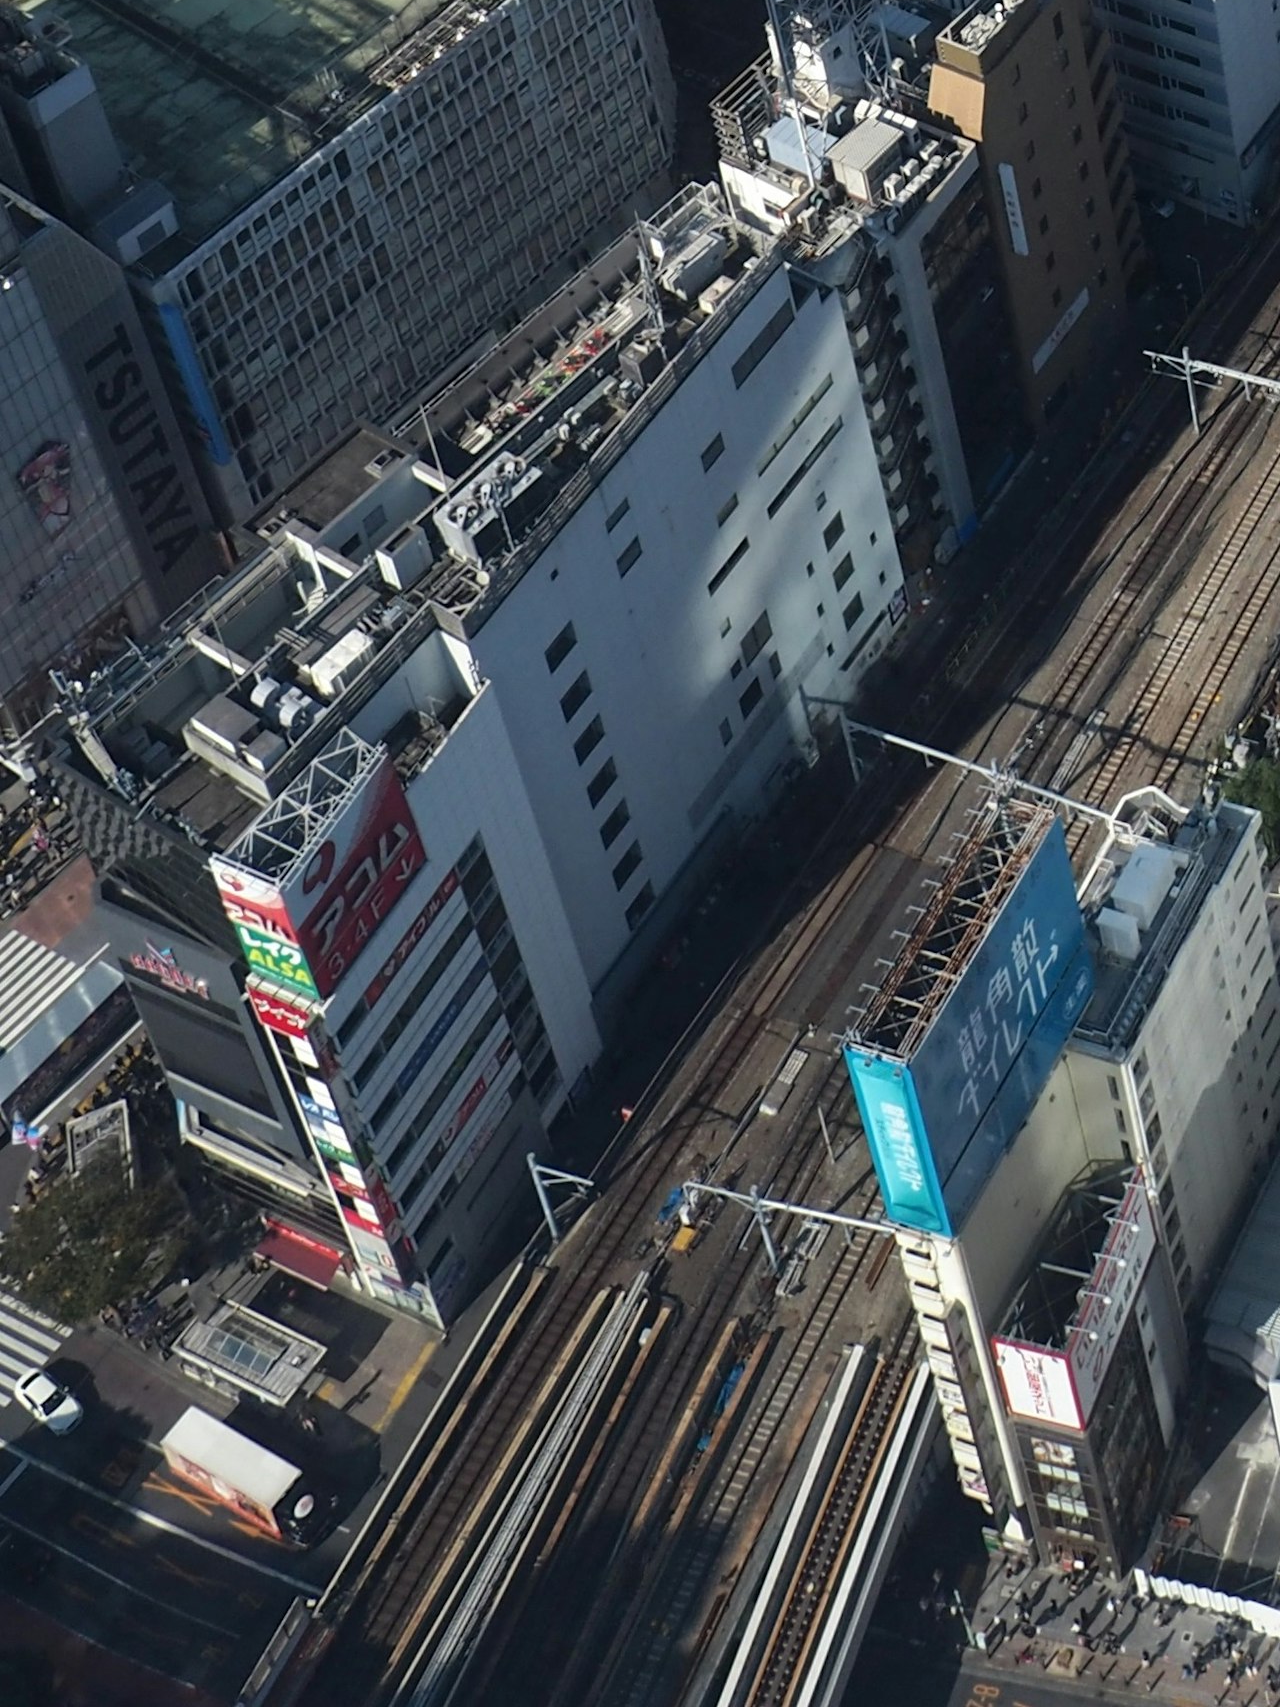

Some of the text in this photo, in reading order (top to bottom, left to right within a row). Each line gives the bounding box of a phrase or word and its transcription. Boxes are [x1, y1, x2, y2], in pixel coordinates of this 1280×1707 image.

[84, 320, 201, 577] TSUTAYA
[311, 821, 411, 956] アコム
[239, 926, 302, 966] レイク
[397, 894, 441, 959] アイフル
[248, 948, 312, 986] ALSA
